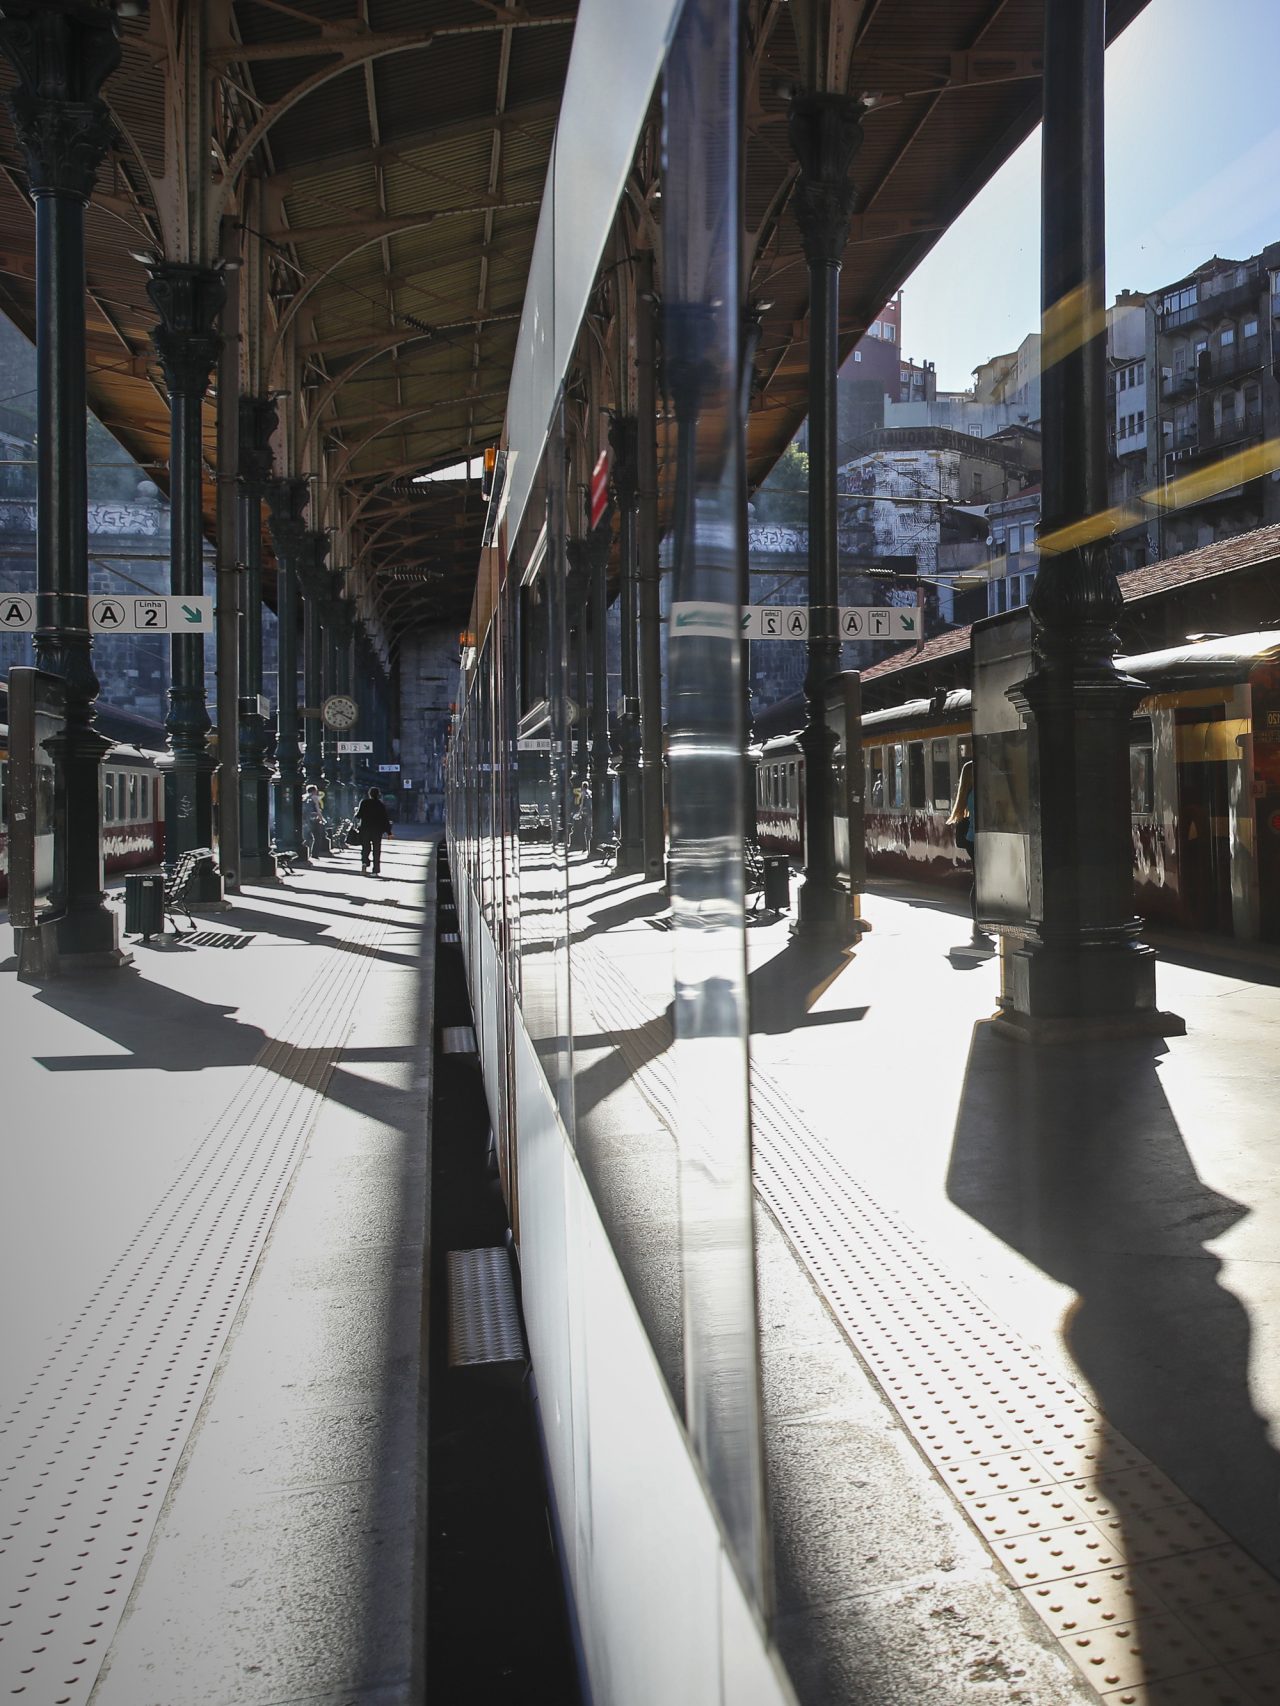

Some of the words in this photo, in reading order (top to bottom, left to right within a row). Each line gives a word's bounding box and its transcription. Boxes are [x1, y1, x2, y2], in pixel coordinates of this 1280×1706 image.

[5, 604, 25, 621] A
[99, 606, 118, 623] A
[145, 609, 158, 626] 2
